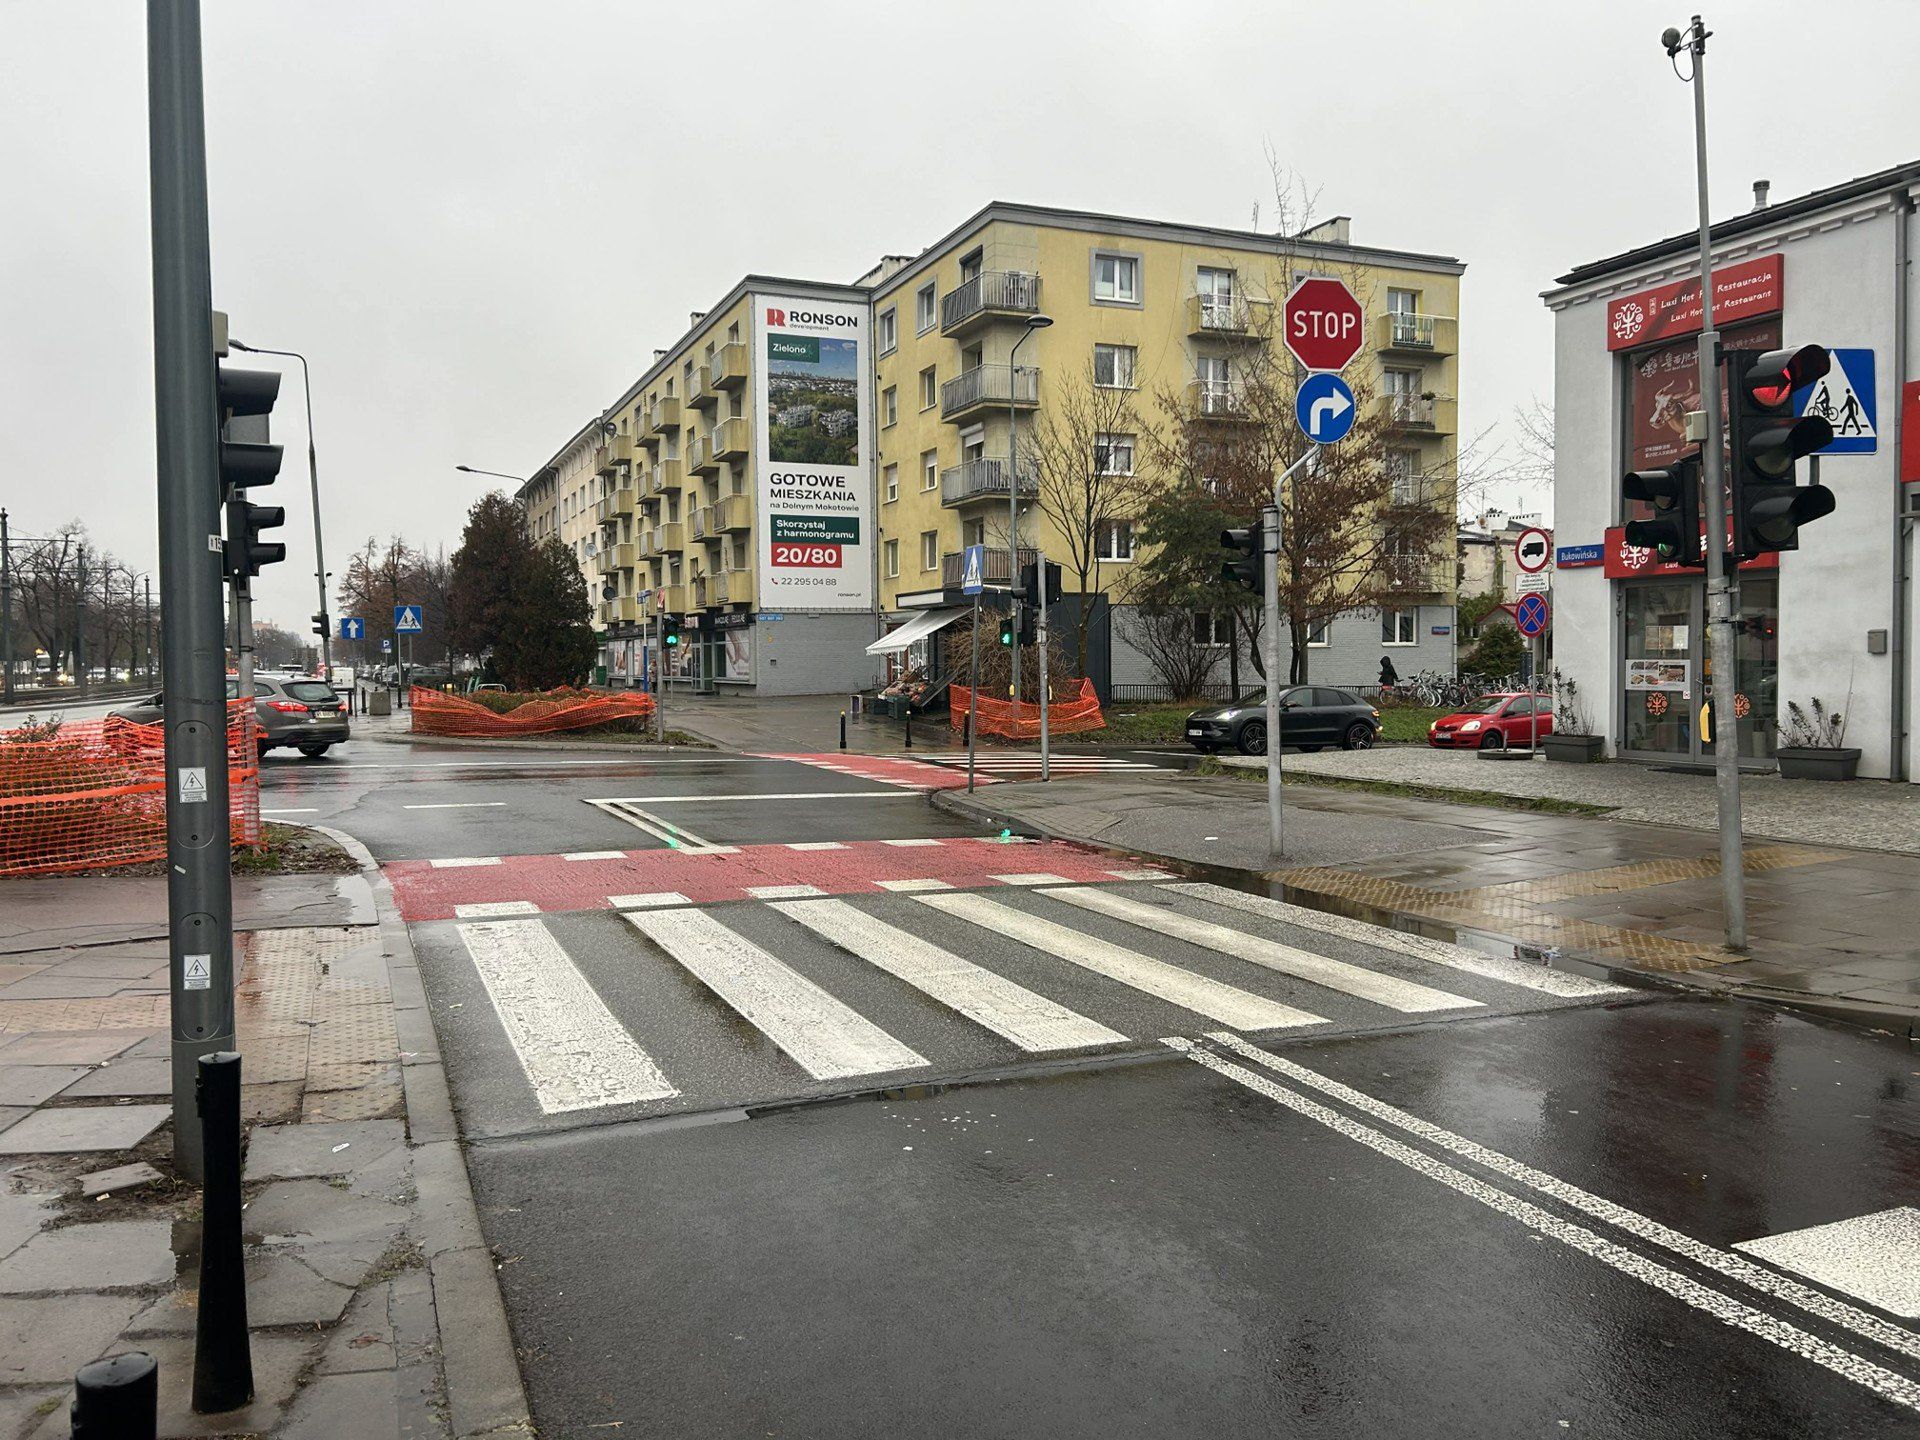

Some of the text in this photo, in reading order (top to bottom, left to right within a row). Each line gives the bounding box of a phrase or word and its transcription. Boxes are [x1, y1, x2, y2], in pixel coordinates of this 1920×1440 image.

[1661, 298, 1677, 308] Luxi
[1681, 293, 1694, 302] Hot
[1717, 273, 1771, 293] Restauracja
[1670, 313, 1687, 322] Luxi
[1724, 290, 1771, 308] Restaurant
[790, 311, 858, 327] RONSON
[1293, 309, 1356, 339] STOP
[773, 343, 806, 353] Zielono
[770, 472, 846, 488] GOTOWE
[770, 488, 856, 501] MIESZKANIA
[782, 502, 814, 511] Dolnym
[815, 504, 860, 512] Mokotowie
[776, 519, 826, 530] Skorzystaj
[784, 529, 855, 539] harmonogramu
[776, 547, 837, 565] 20/80
[1561, 550, 1598, 561] Bukowińska
[781, 577, 837, 586] 22 295 04 88
